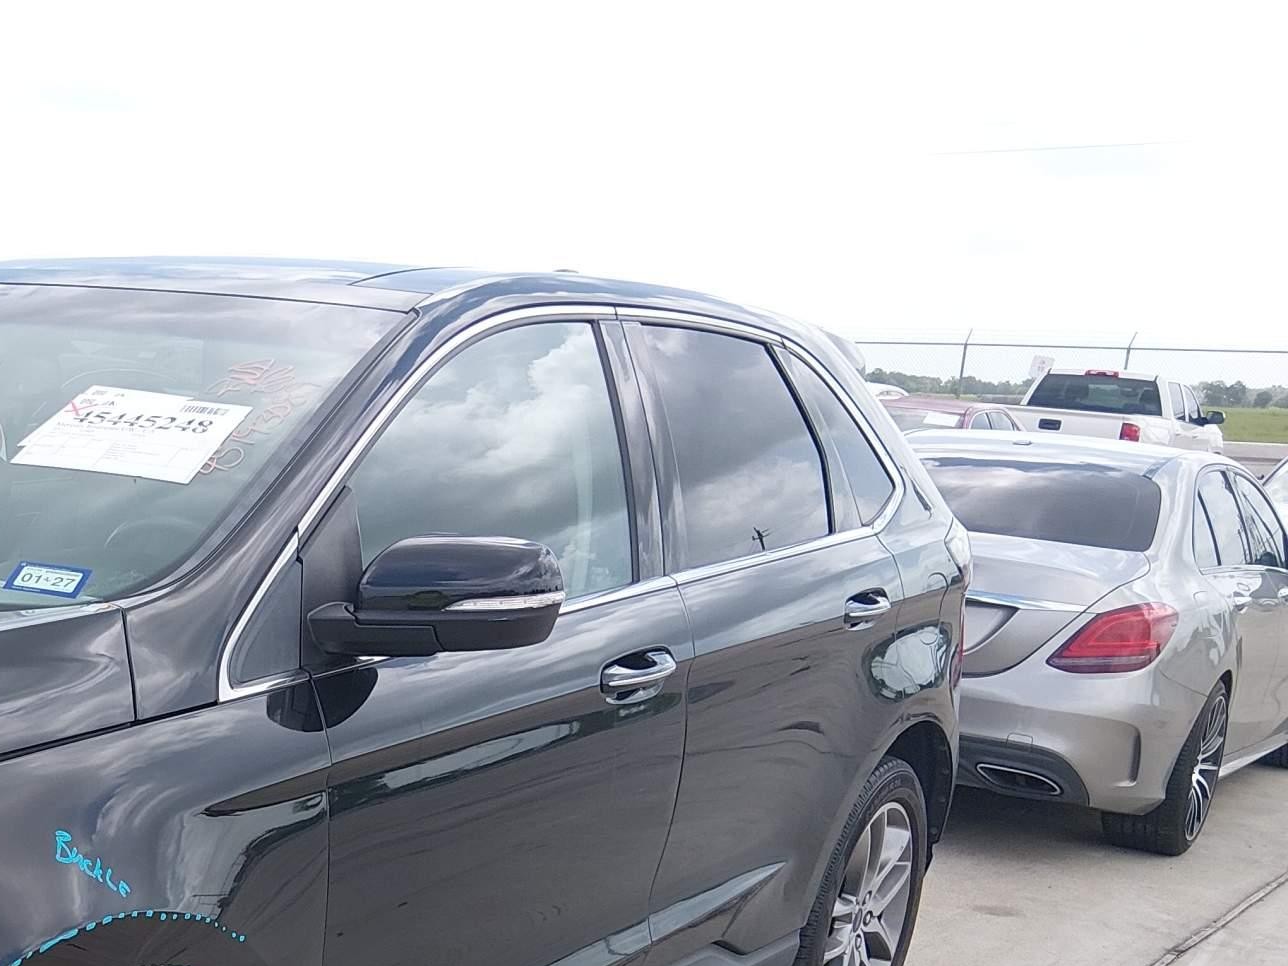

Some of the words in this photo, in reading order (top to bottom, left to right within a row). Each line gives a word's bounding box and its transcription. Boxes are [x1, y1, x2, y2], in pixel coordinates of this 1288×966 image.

[73, 410, 214, 434] 45445248
[20, 573, 43, 584] 01
[51, 576, 76, 588] 27
